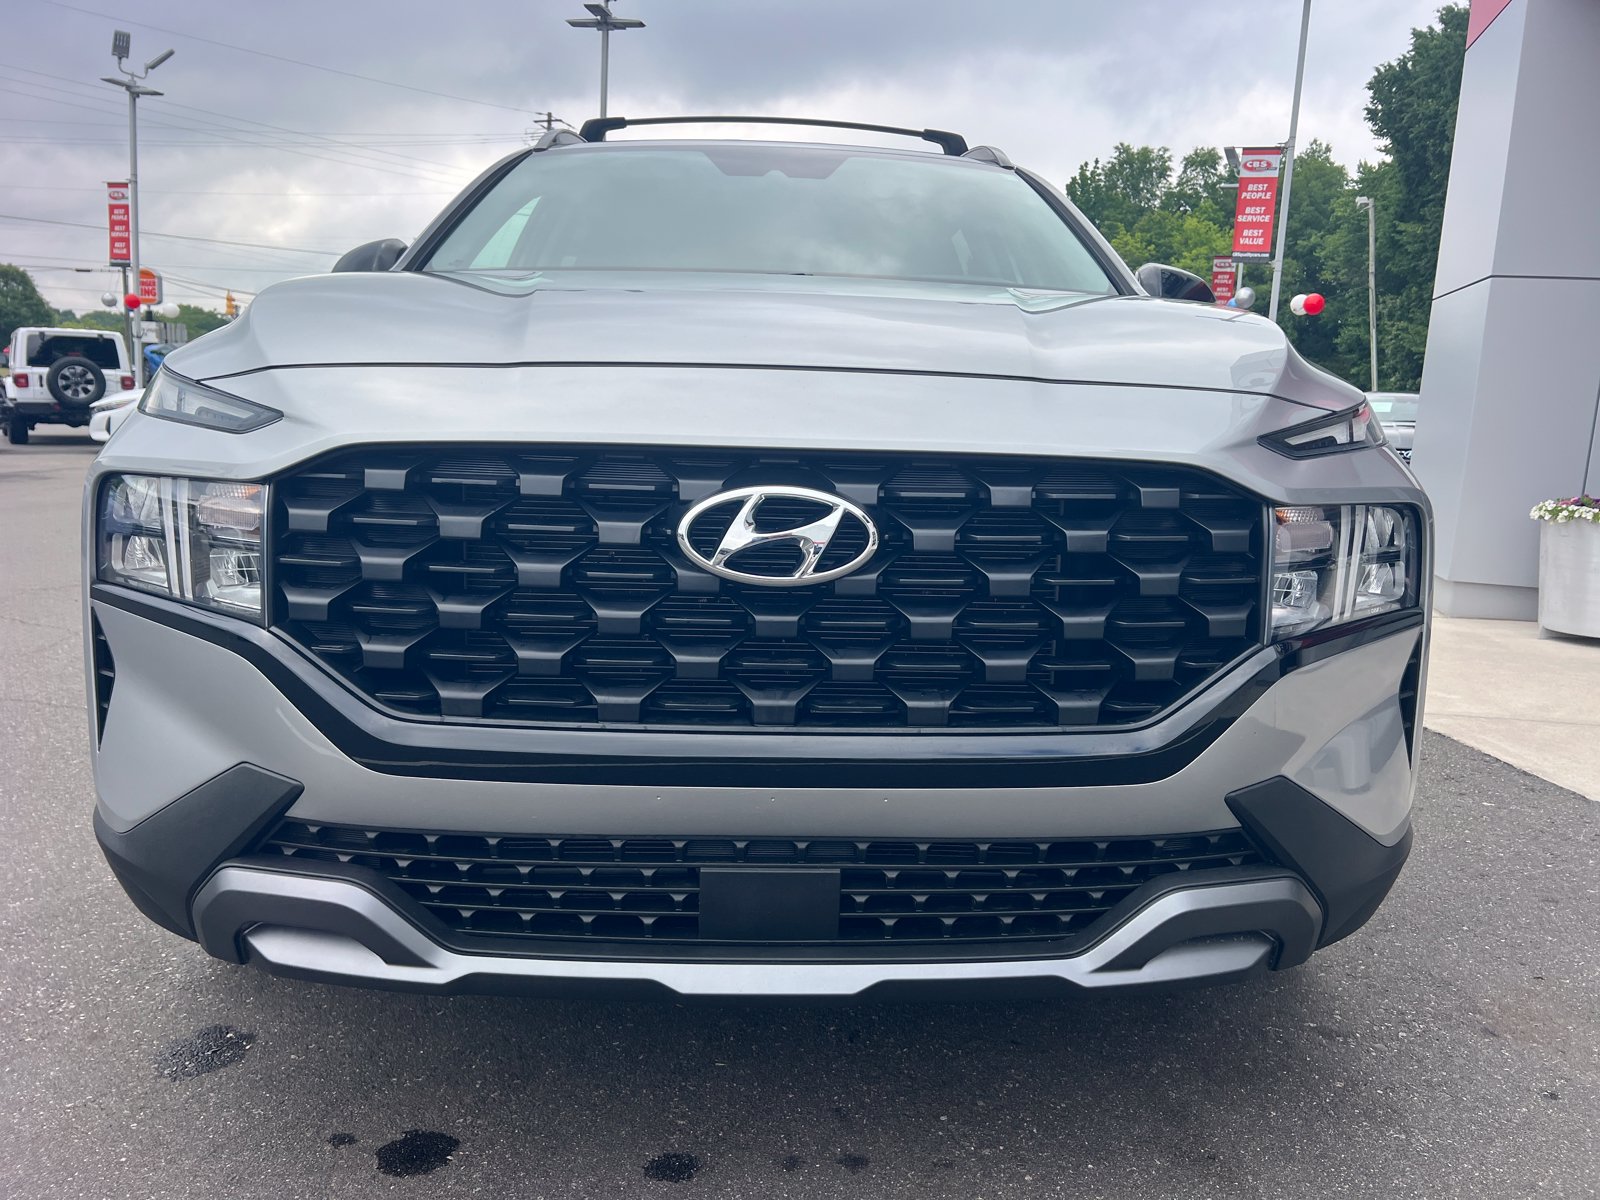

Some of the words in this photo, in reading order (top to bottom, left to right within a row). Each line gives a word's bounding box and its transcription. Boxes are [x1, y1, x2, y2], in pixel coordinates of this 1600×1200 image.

[1237, 215, 1270, 223] SERVICE
[1242, 229, 1264, 237] BEST
[1239, 237, 1265, 245] VALUE
[140, 286, 157, 297] ING
